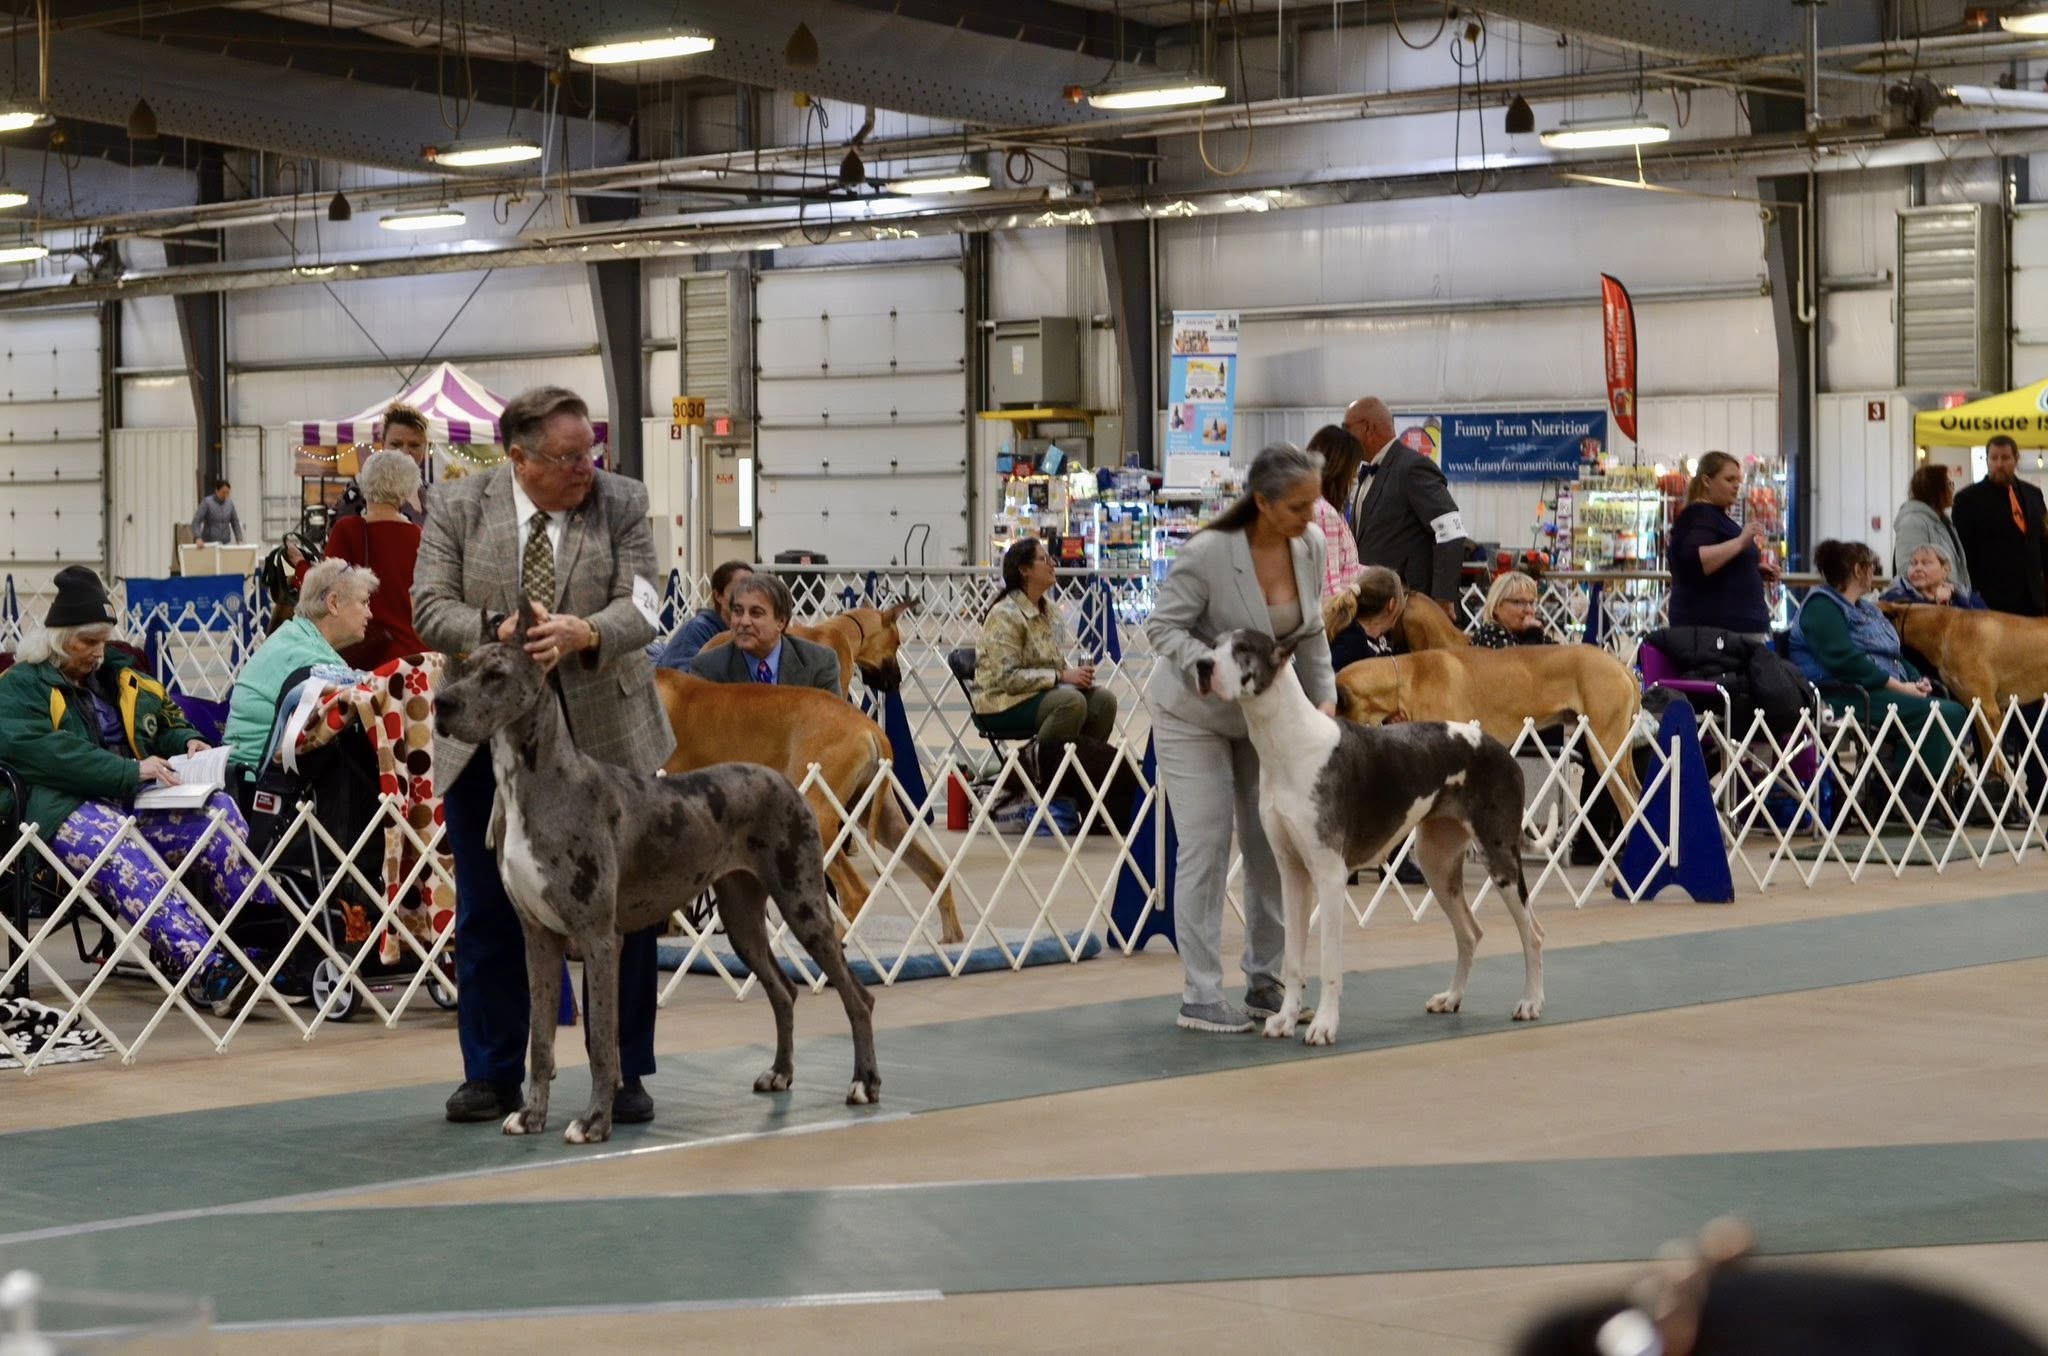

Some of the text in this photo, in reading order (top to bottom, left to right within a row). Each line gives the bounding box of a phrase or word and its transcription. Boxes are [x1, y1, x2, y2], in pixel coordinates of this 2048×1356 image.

[1872, 402, 1881, 419] 3
[1455, 418, 1590, 442] Funny Farm Nutrition
[1940, 414, 2029, 431] Outside
[672, 425, 680, 438] 2
